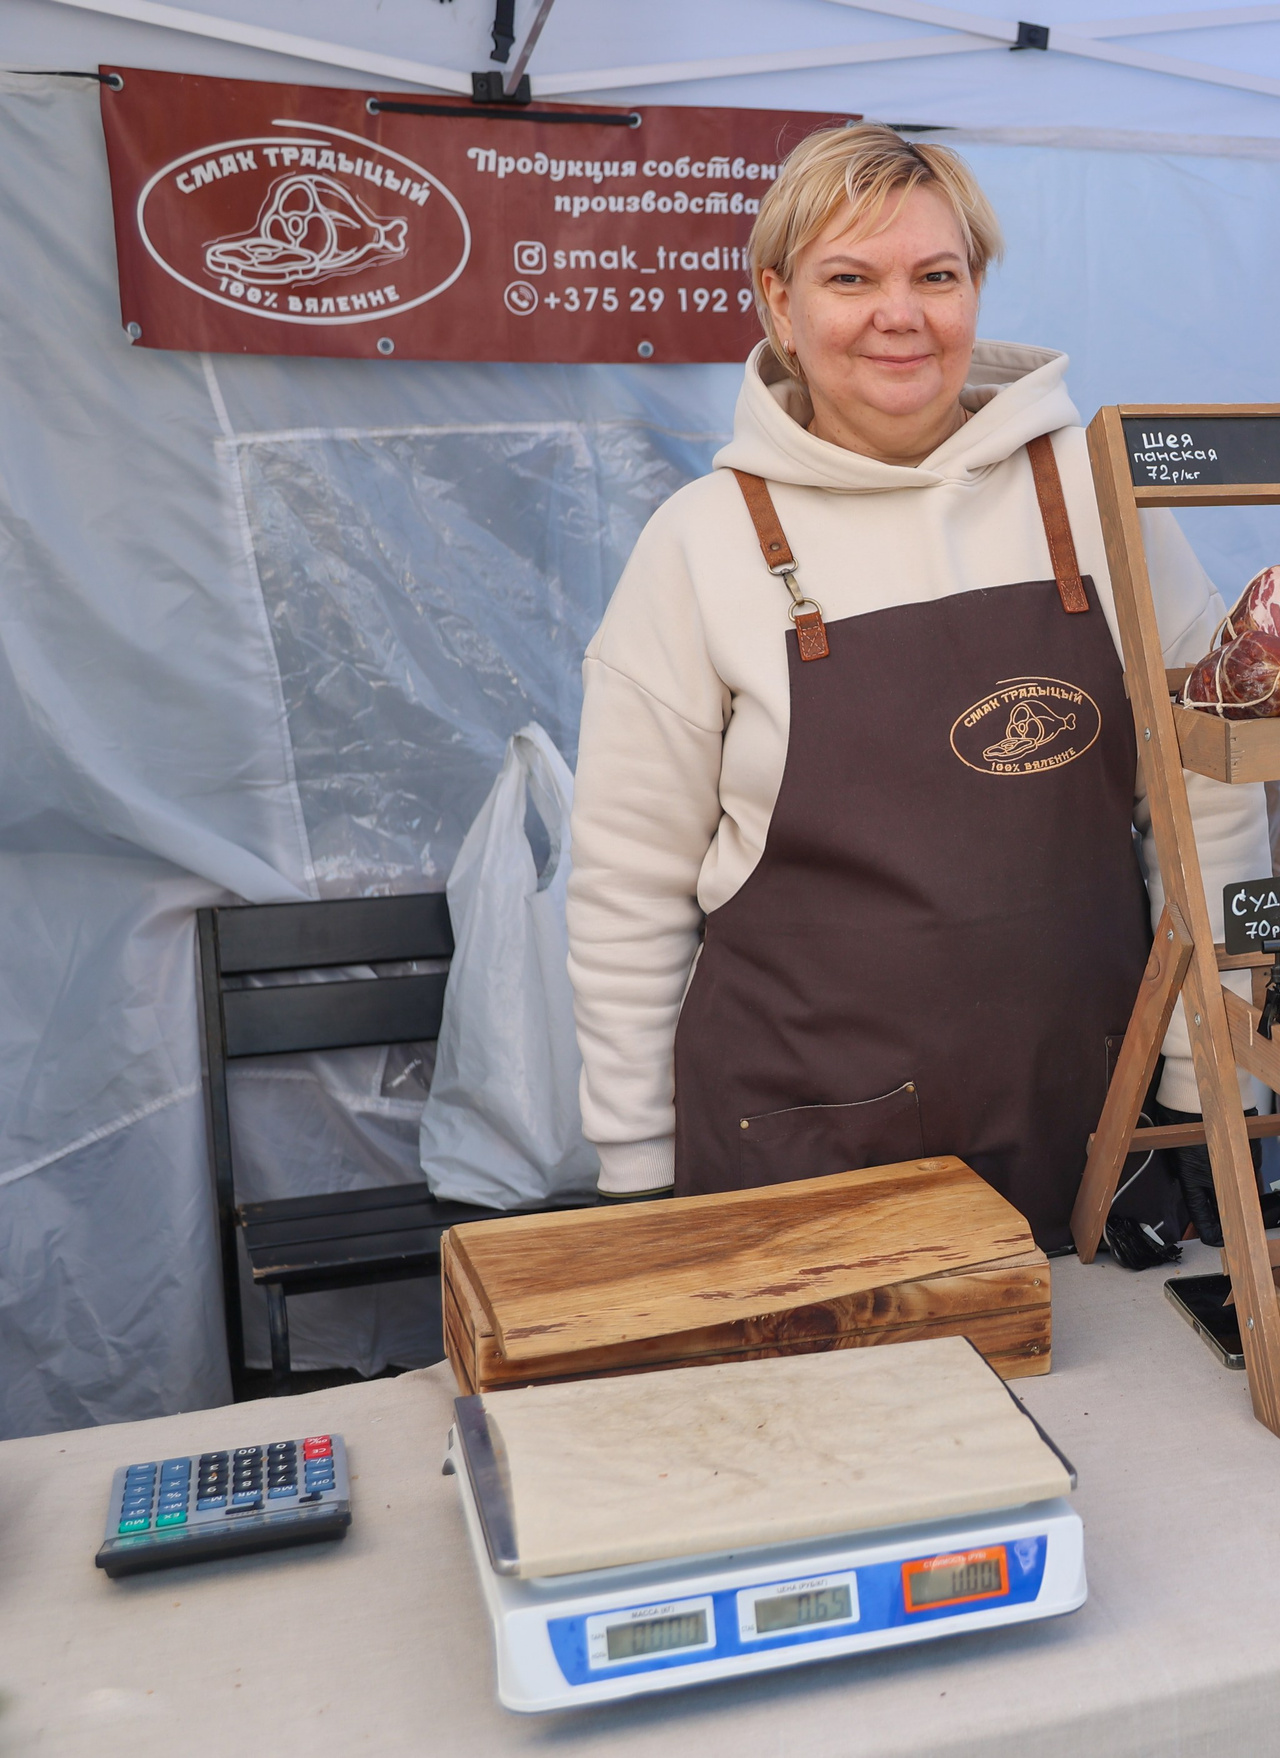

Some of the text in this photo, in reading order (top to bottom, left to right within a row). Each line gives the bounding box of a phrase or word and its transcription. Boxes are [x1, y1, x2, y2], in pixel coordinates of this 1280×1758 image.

[174, 146, 432, 207] СМАК ТРАДЫЦЫЙ
[467, 147, 637, 184] Продукция
[554, 190, 760, 218] производства
[218, 276, 400, 314] 100% ВЯЛЕННЕ
[543, 287, 753, 313] +375 29 192 9
[1142, 431, 1194, 449] Шея
[1134, 449, 1218, 464] панская
[1146, 464, 1201, 484] 72р/кг
[963, 686, 1083, 728] СМАК ТРАДЫЦЫЙ
[991, 762, 1020, 772] 100%
